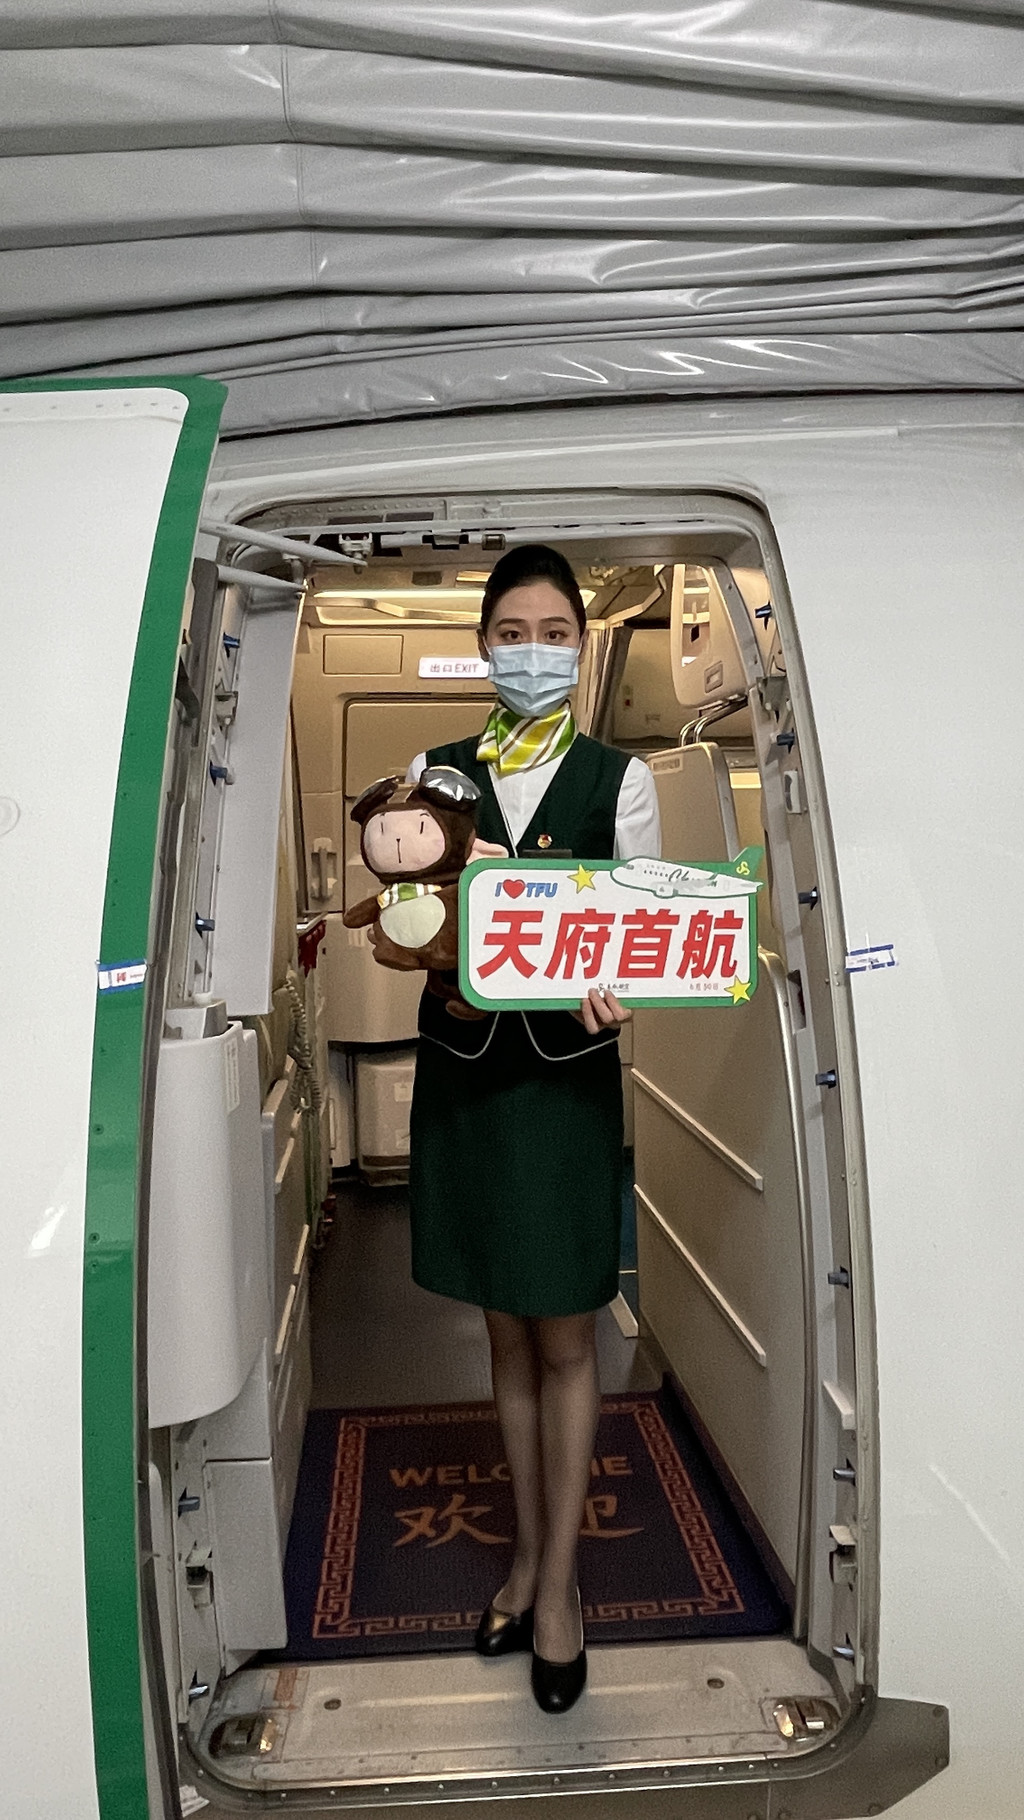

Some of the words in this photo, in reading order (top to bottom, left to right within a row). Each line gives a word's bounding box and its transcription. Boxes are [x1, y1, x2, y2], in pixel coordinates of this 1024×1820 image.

[430, 663, 453, 673] 出口
[454, 663, 479, 673] EXIT
[526, 882, 558, 898] TFU
[476, 908, 744, 980] 天府首航
[390, 1456, 633, 1488] WELCE
